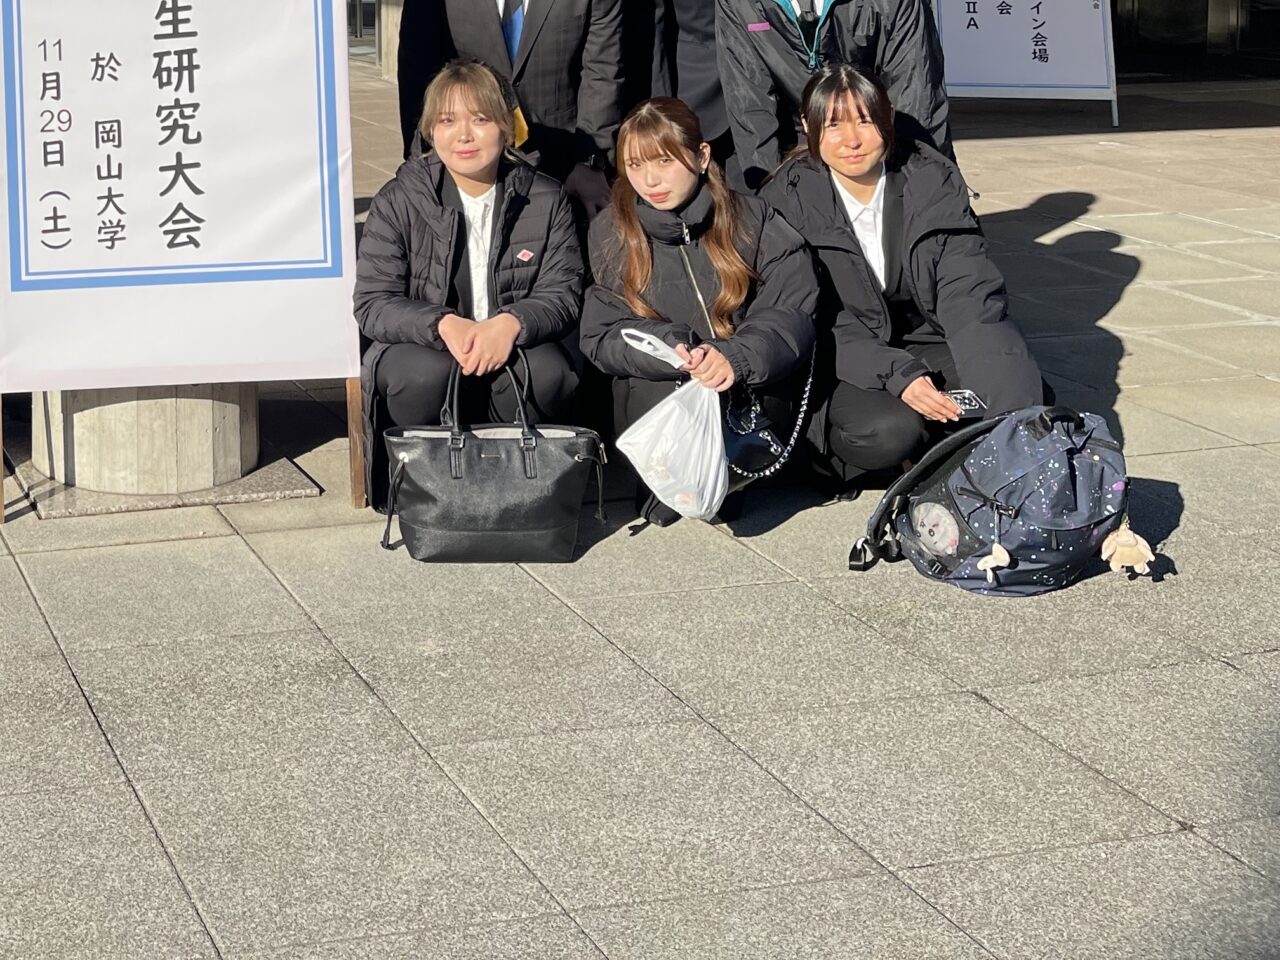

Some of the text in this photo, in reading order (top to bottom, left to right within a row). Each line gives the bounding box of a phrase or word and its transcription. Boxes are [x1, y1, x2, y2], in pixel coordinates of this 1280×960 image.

[90, 50, 127, 251] 於 岡山大学
